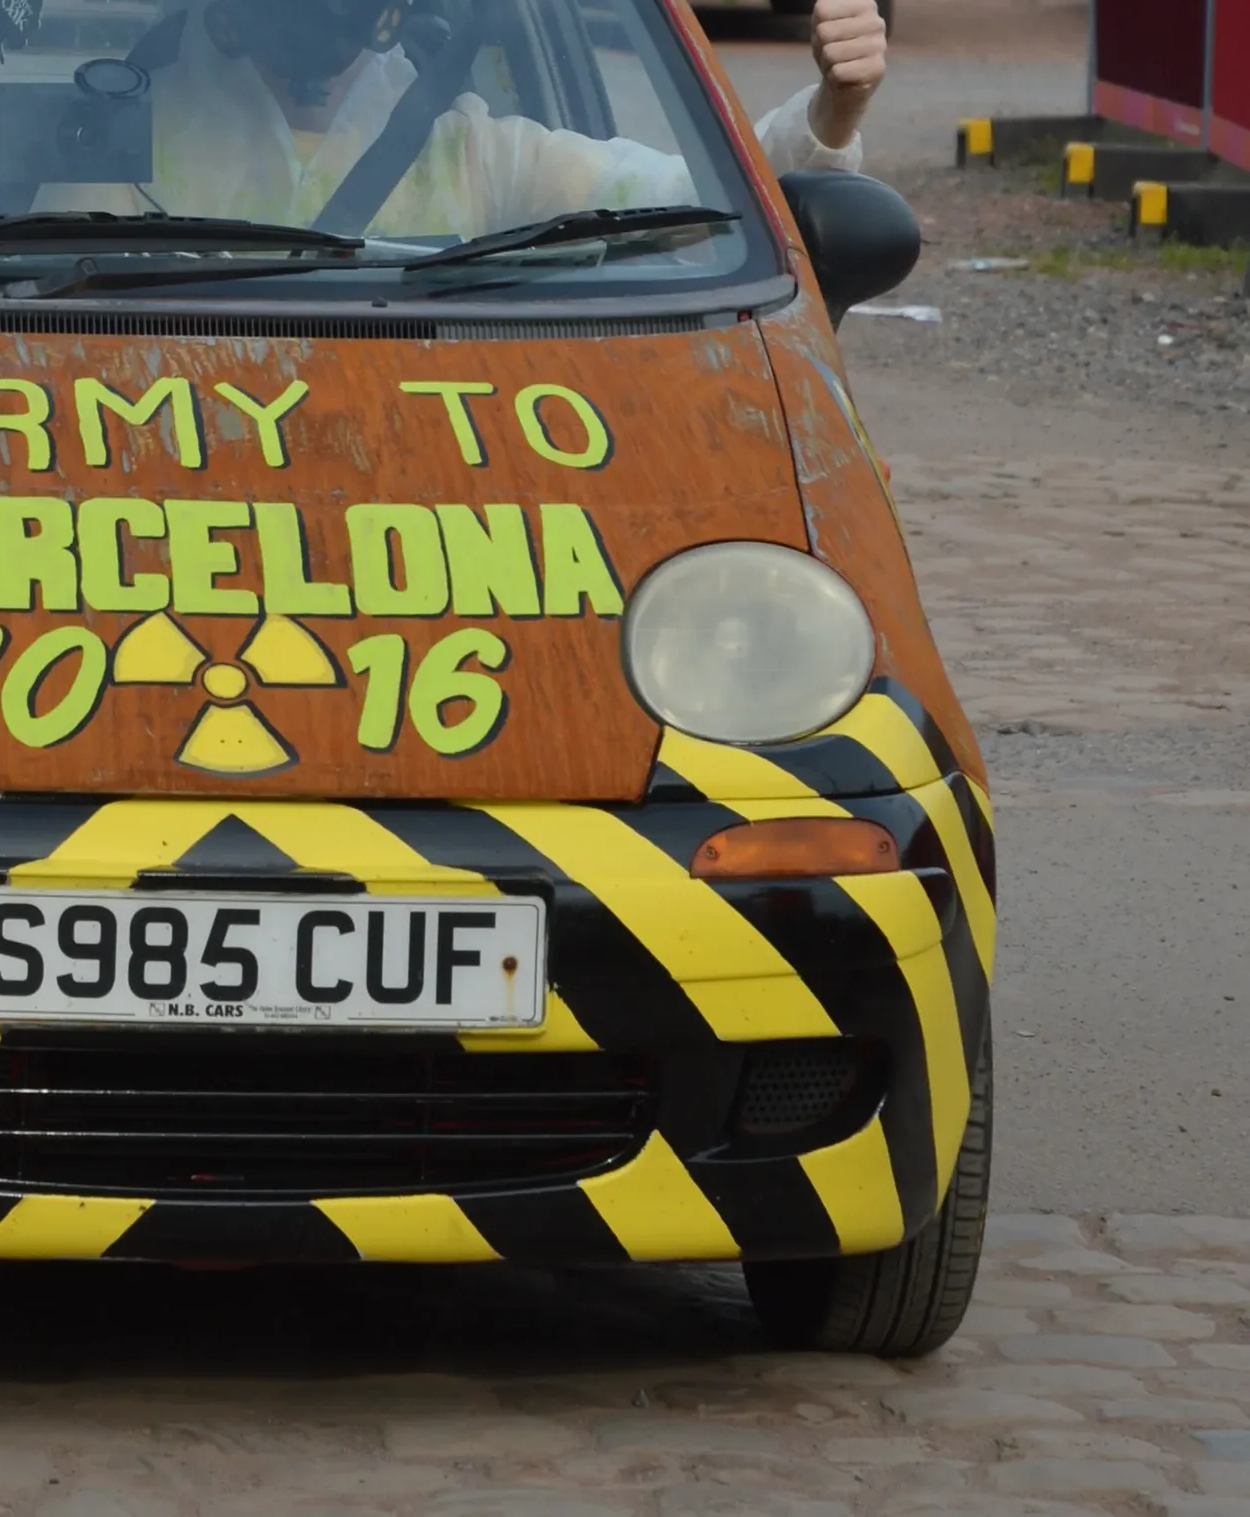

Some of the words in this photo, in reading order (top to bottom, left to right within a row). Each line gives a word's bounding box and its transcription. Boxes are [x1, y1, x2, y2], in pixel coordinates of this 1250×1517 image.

[397, 379, 613, 470] TO
[295, 909, 498, 1006] CUF
[168, 1003, 200, 1017] N.B.
[205, 1003, 244, 1018] CARS
